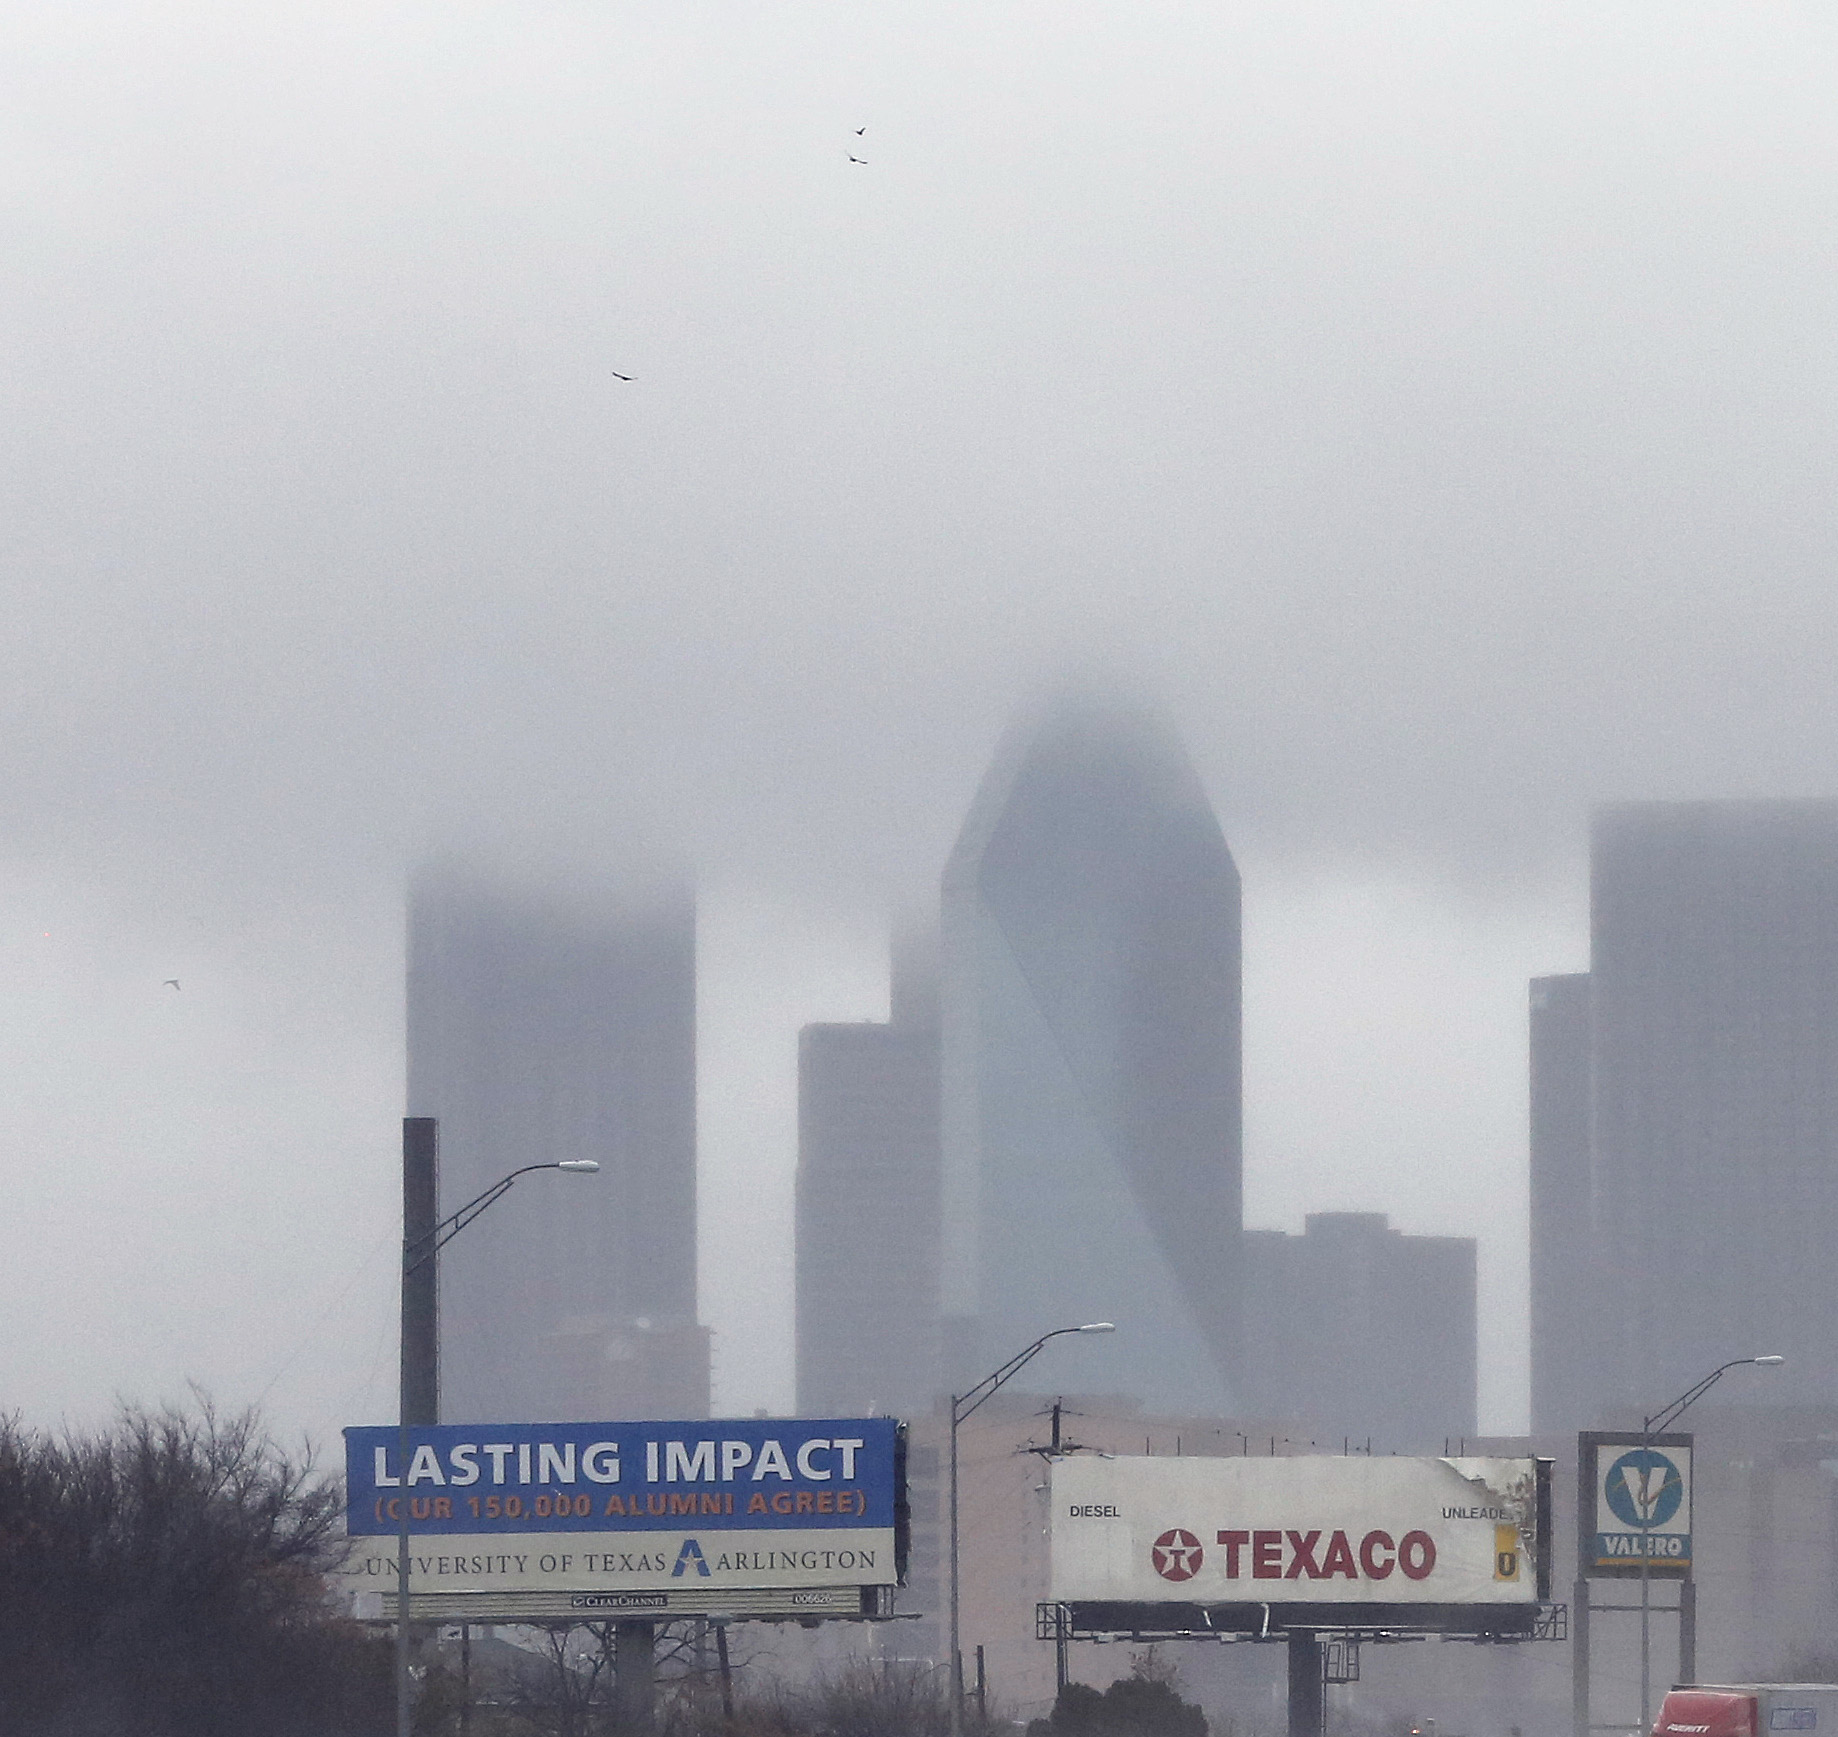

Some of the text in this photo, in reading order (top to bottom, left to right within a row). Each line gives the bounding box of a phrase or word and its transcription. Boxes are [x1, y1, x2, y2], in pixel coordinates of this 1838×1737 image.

[374, 1439, 864, 1487] LASTING IMPACT
[468, 1494, 593, 1520] 150,000
[603, 1492, 733, 1517] ALUMNI
[747, 1490, 866, 1517] AGREE)
[1069, 1506, 1120, 1518] DIESEL
[1442, 1507, 1515, 1520] UNLEADE
[1217, 1529, 1437, 1580] TEXACO
[1605, 1536, 1682, 1556] VALERO
[365, 1554, 528, 1576] UNIVERSITY
[539, 1554, 573, 1574] OF
[584, 1553, 666, 1572] TEXAS
[716, 1551, 877, 1571] ARLINGTON
